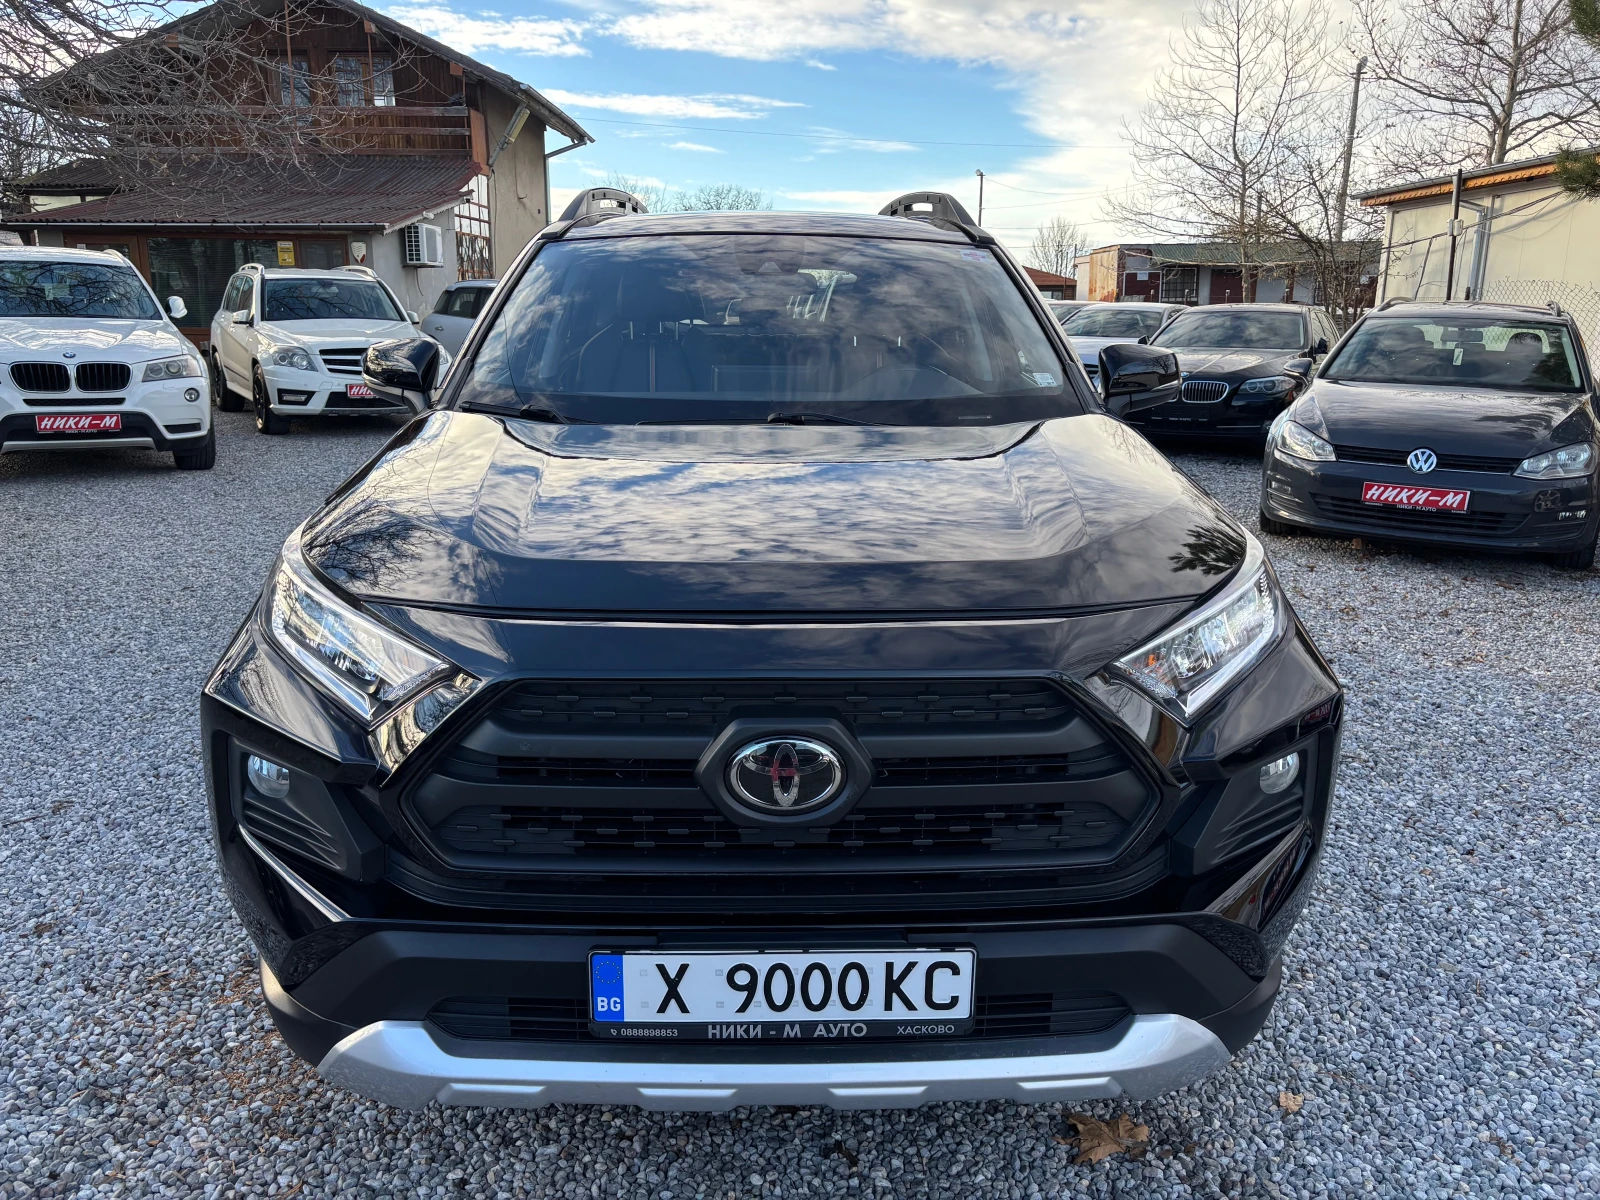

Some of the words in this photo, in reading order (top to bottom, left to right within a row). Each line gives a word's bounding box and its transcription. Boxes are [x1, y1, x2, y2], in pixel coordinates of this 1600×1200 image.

[40, 415, 118, 429] НИКИ-М
[1365, 485, 1464, 508] НИКИ-М
[726, 961, 870, 1013] 9000
[597, 996, 621, 1012] BG
[620, 1028, 679, 1037] 0888898853
[707, 1024, 762, 1039] НИКИ
[813, 1022, 868, 1038] АУТО
[896, 1024, 955, 1035] ХАСКОВО
